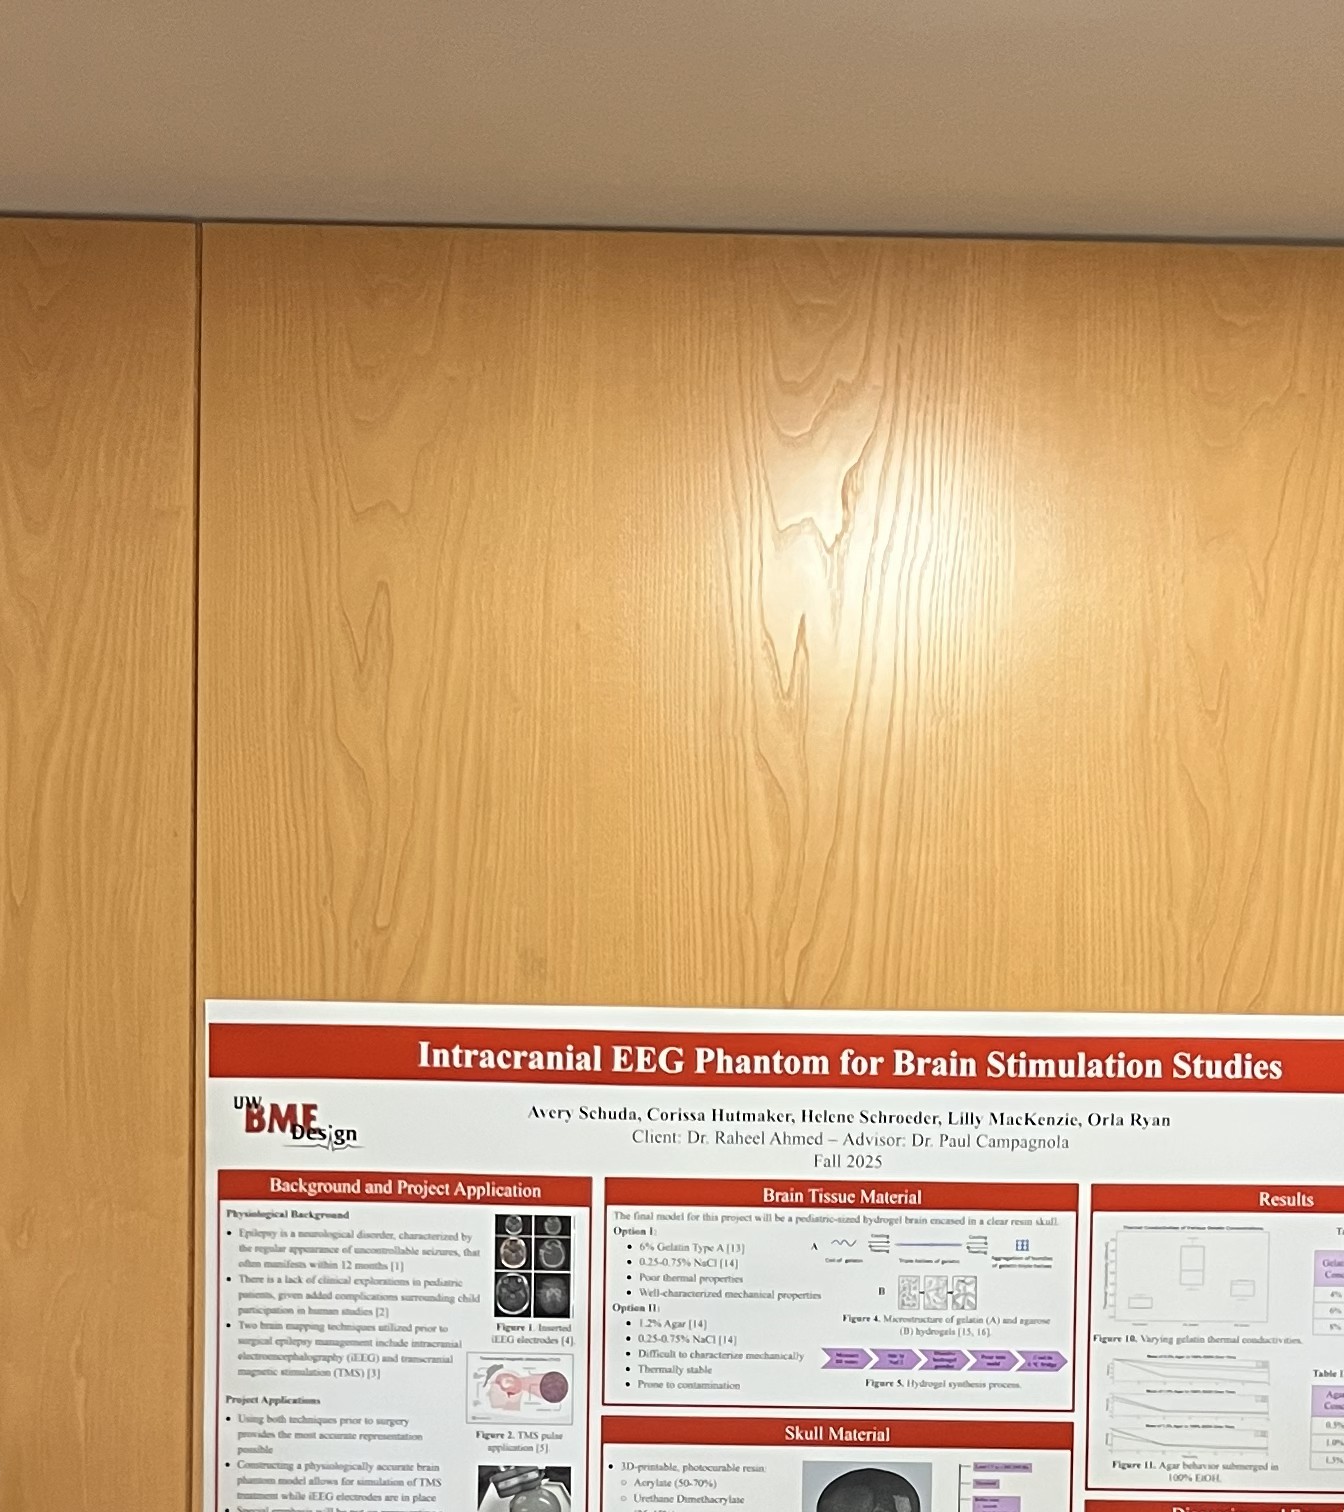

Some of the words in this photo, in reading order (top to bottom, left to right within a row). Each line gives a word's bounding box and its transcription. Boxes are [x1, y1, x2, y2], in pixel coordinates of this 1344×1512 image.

[418, 1041, 601, 1072] Intracranial
[611, 1045, 684, 1074] EEG
[693, 1046, 830, 1075] Phantom
[839, 1047, 885, 1076] for
[892, 1048, 977, 1077] Brain
[986, 1049, 1162, 1079] Stimulation
[1172, 1051, 1283, 1080] Studies
[234, 1096, 262, 1109] UW
[245, 1103, 318, 1133] BME
[528, 1106, 571, 1123] Avery
[578, 1105, 642, 1122] Schuda,
[646, 1106, 705, 1122] Corissa
[711, 1107, 795, 1124] Hutmaker,
[801, 1108, 854, 1124] Helene
[859, 1109, 942, 1126] Schroeder,
[947, 1111, 981, 1130] Lilly
[989, 1111, 1082, 1128] MacKenzie,
[1087, 1112, 1124, 1127] Orla
[1130, 1112, 1170, 1130] Ryan
[292, 1124, 357, 1146] Design
[632, 1129, 681, 1144] Client:
[688, 1130, 709, 1144] Dr.
[715, 1129, 765, 1145] Raheel
[769, 1130, 823, 1146] Ahmed
[843, 1132, 906, 1147] Advisor:
[912, 1133, 933, 1147] Dr.
[939, 1132, 971, 1148] Paul
[975, 1133, 1069, 1153] Campagnola
[813, 1153, 841, 1168] Fall
[846, 1153, 882, 1169] 2025
[269, 1176, 361, 1197] Background
[364, 1178, 393, 1195] and
[397, 1179, 450, 1200] Project
[453, 1180, 541, 1201] Application
[763, 1186, 804, 1203] Brain
[807, 1187, 856, 1204] Tissue
[859, 1188, 922, 1205] Material
[1259, 1190, 1315, 1207] Results
[612, 1226, 647, 1238] Option
[656, 1242, 690, 1253] Gelatin
[691, 1243, 715, 1255] Type
[715, 1244, 725, 1254] A
[725, 1243, 746, 1256] [13]
[693, 1257, 717, 1268] NaCl
[719, 1257, 739, 1270] [14]
[638, 1272, 661, 1282] Poor
[662, 1272, 697, 1283] thermal
[698, 1274, 744, 1286] properties
[638, 1287, 723, 1298] Well-characterized
[724, 1288, 775, 1299] mechanical
[776, 1291, 822, 1302] properties
[611, 1302, 646, 1315] Option
[663, 1318, 687, 1331] Agar
[687, 1319, 708, 1332] [14]
[691, 1334, 716, 1345] NaCl
[717, 1334, 737, 1347] [14]
[637, 1348, 676, 1359] Difficult
[677, 1350, 688, 1359] to
[689, 1349, 743, 1360] characterize
[745, 1350, 805, 1363] mechanically
[637, 1363, 684, 1376] Thermally
[685, 1364, 713, 1375] stable
[637, 1379, 664, 1389] Prone
[665, 1381, 675, 1389] to
[676, 1379, 741, 1390] contamination
[784, 1424, 823, 1441] Skull
[828, 1425, 890, 1442] Material
[620, 1460, 680, 1474] 3D-printable,
[681, 1461, 740, 1475] photocurable
[741, 1465, 766, 1473] resin:
[633, 1477, 672, 1490] Acrylate
[632, 1492, 674, 1504] Urethane
[676, 1493, 745, 1506] Dimethacrylate
